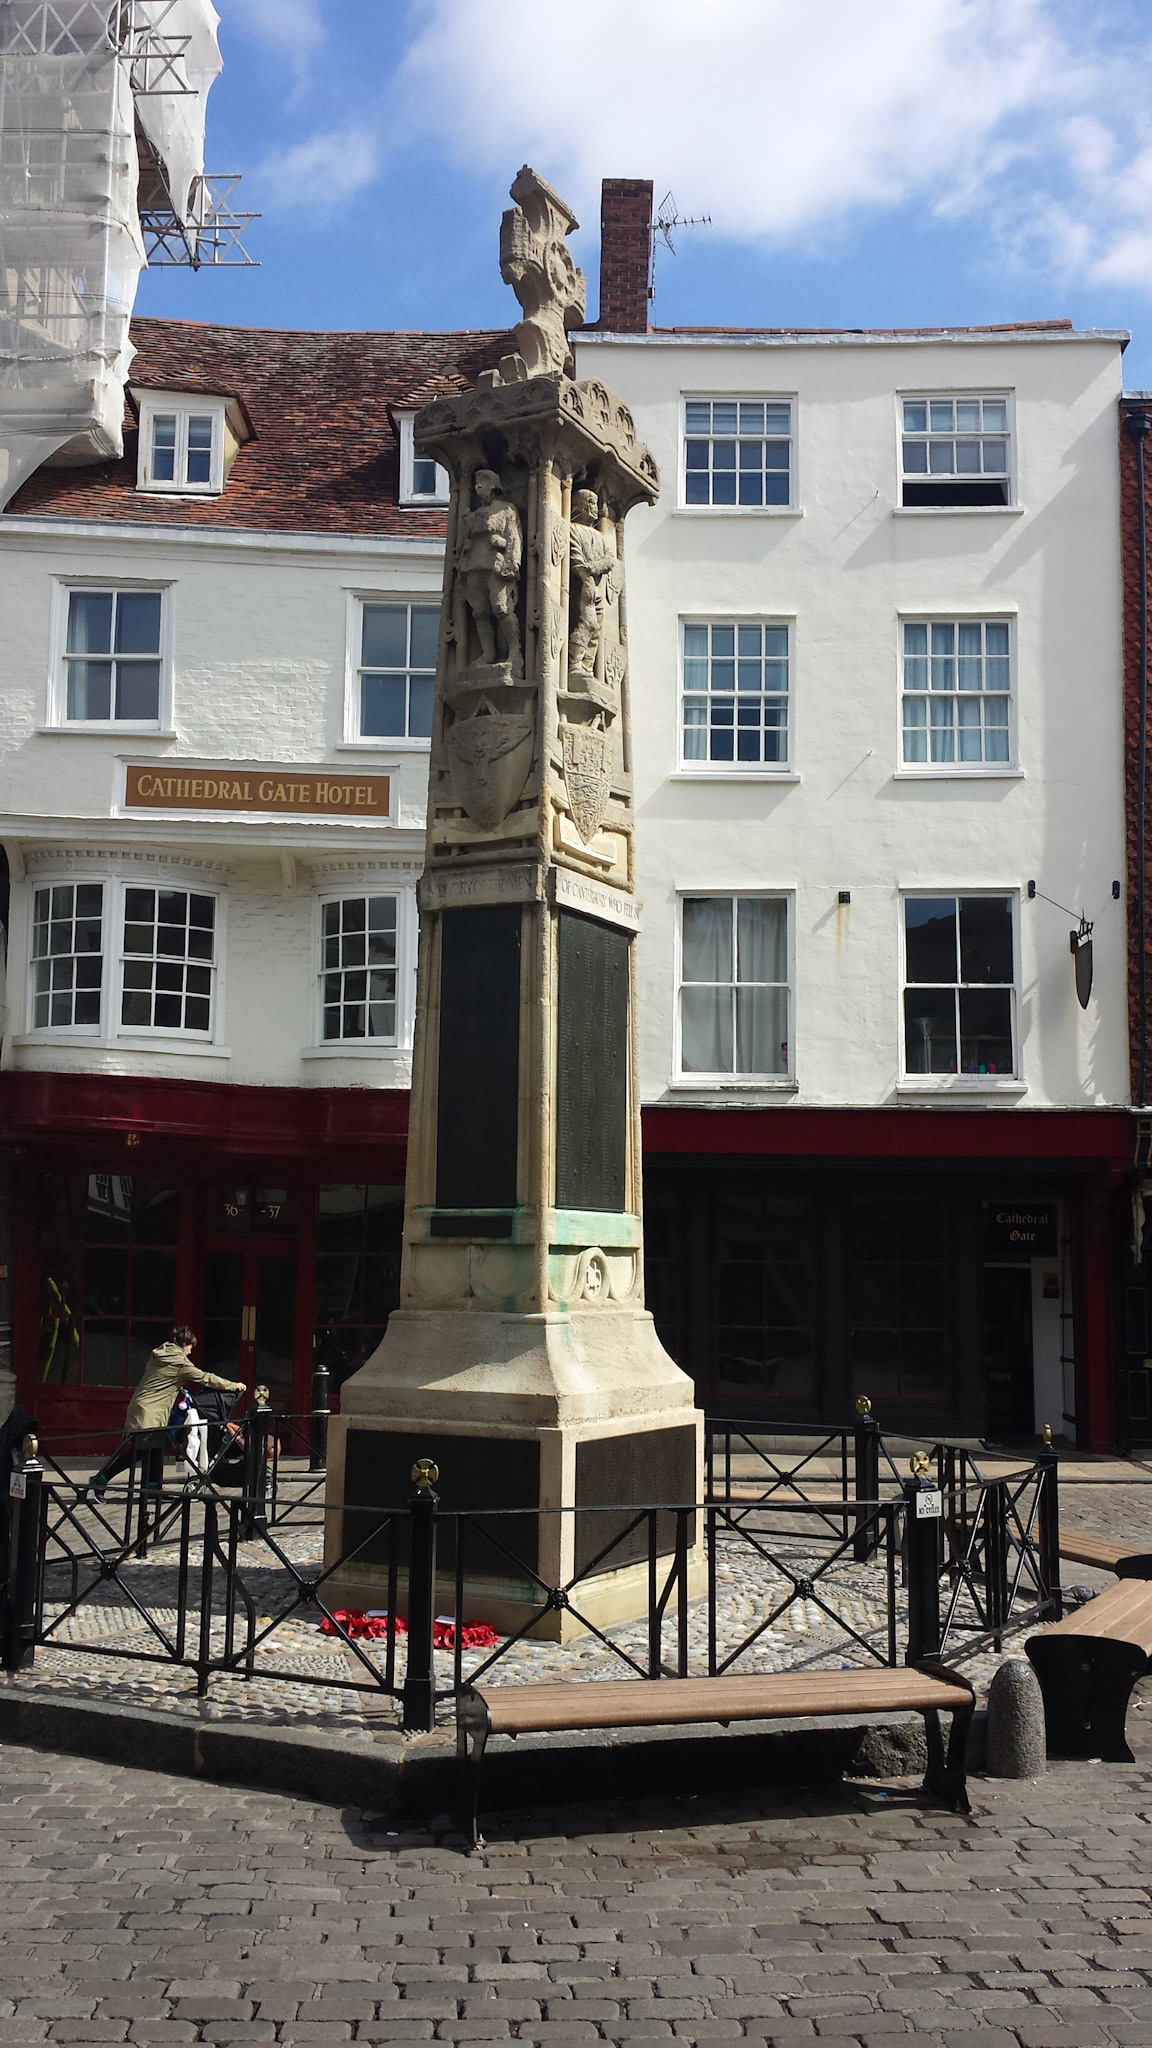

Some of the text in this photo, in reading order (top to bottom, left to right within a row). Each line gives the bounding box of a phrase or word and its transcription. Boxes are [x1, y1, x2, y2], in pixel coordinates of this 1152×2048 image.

[137, 774, 378, 806] CATHEDRAL GATE HOTEL
[996, 1212, 1049, 1225] Cathedral
[1009, 1229, 1036, 1241] Gate
